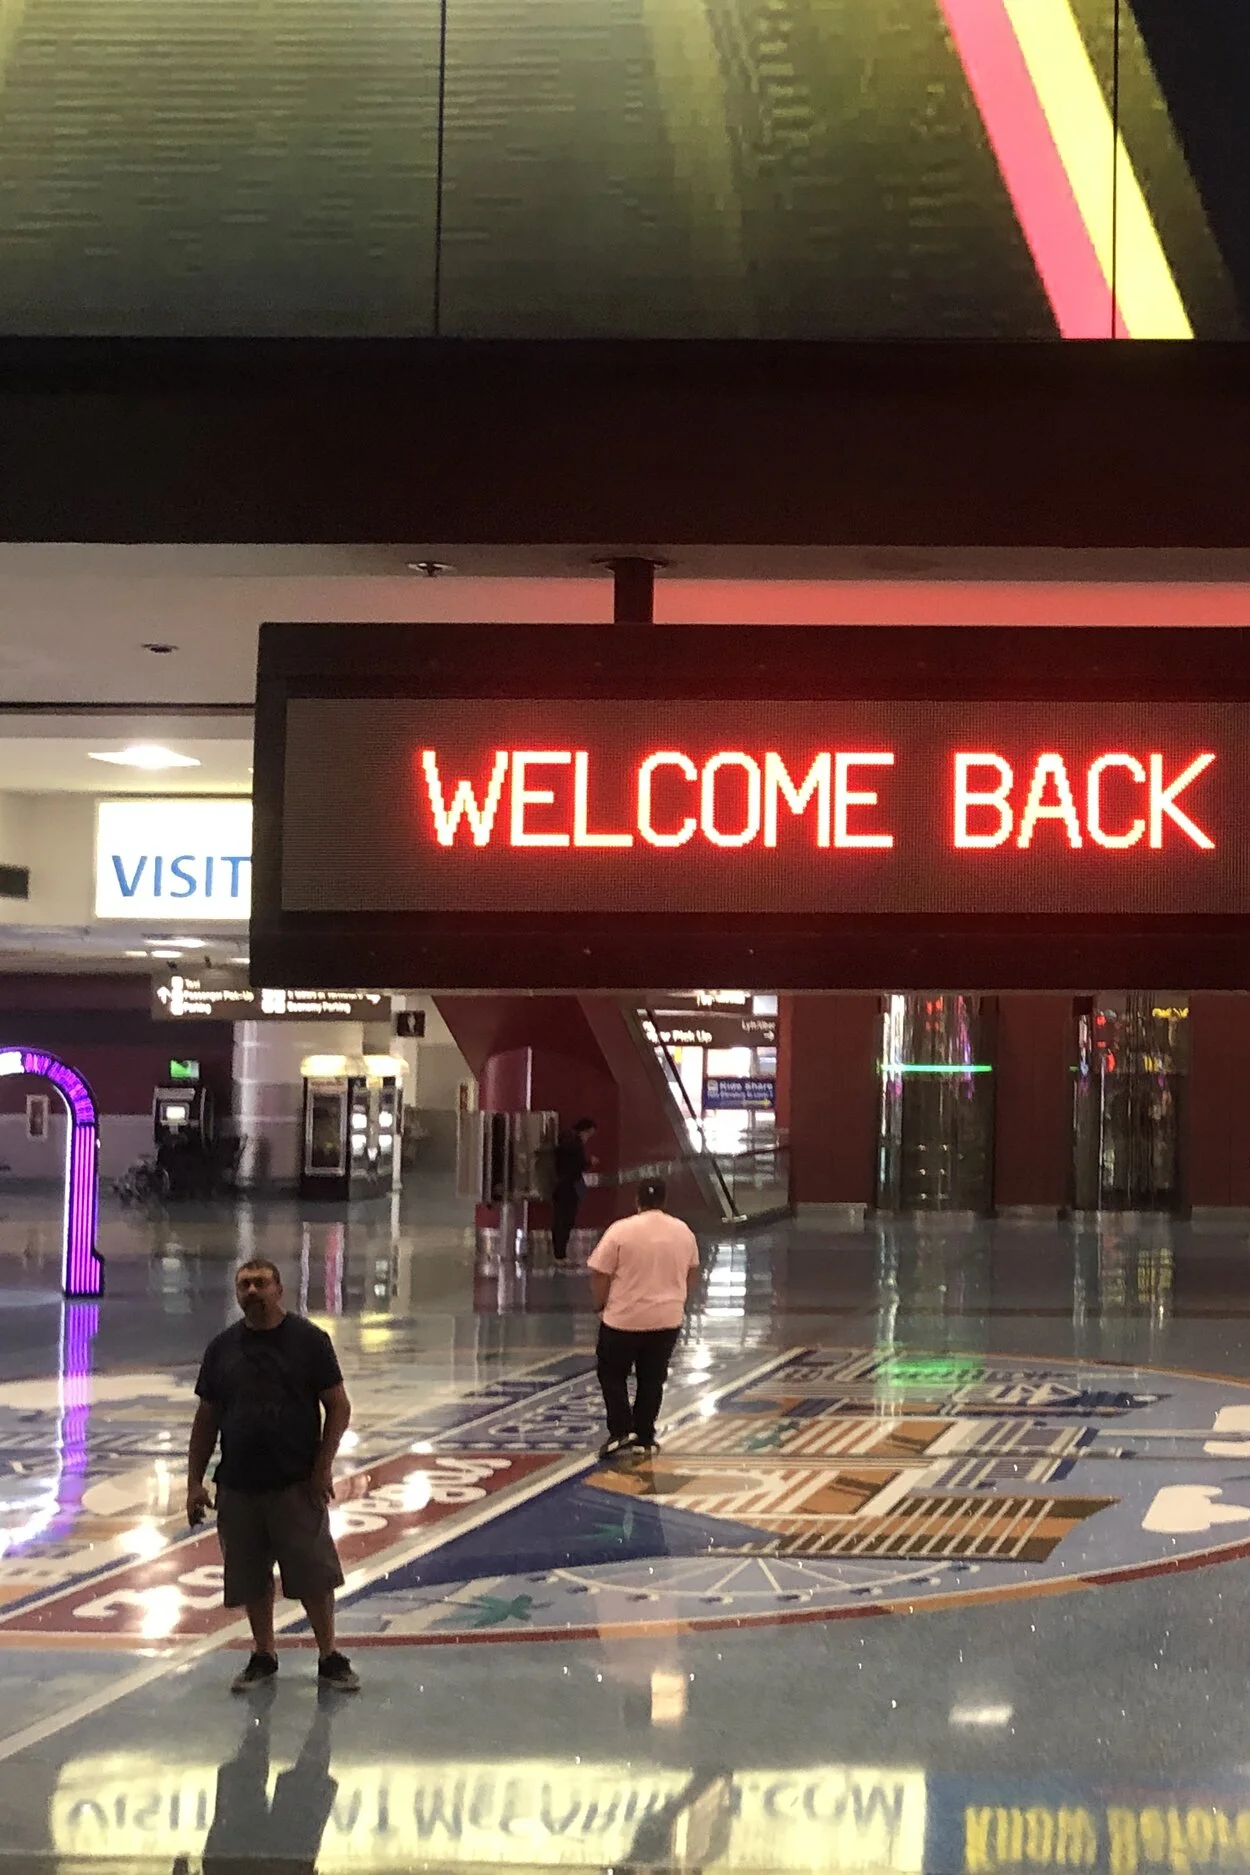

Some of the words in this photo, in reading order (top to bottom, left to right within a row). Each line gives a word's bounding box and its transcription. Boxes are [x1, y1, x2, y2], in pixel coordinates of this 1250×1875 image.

[421, 750, 895, 849] WELCOME
[953, 751, 1216, 850] BACK
[111, 854, 251, 897] VISIT
